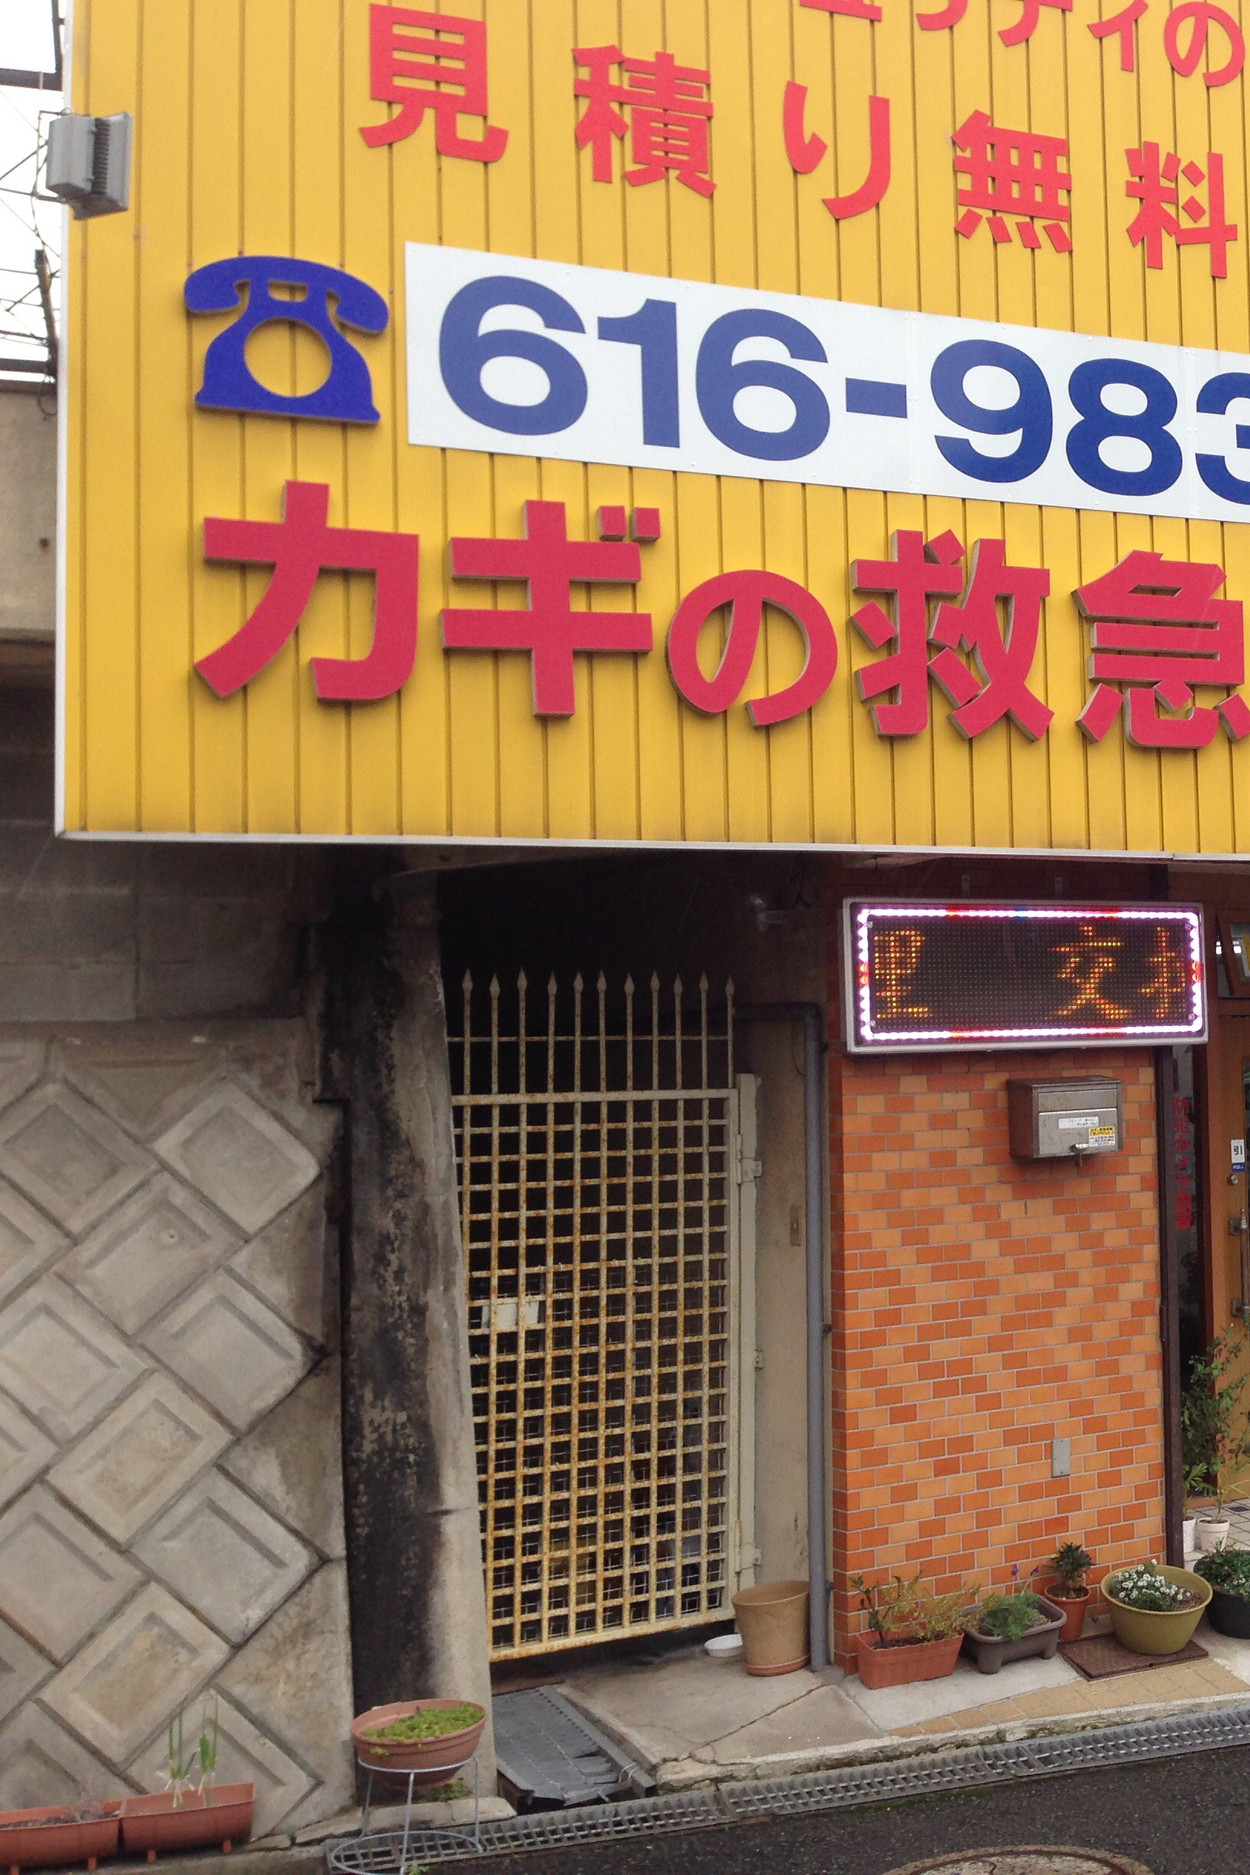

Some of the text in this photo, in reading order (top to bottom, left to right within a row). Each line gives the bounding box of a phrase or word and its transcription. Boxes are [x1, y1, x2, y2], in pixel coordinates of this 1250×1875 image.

[358, 3, 1238, 279] 見積り無料
